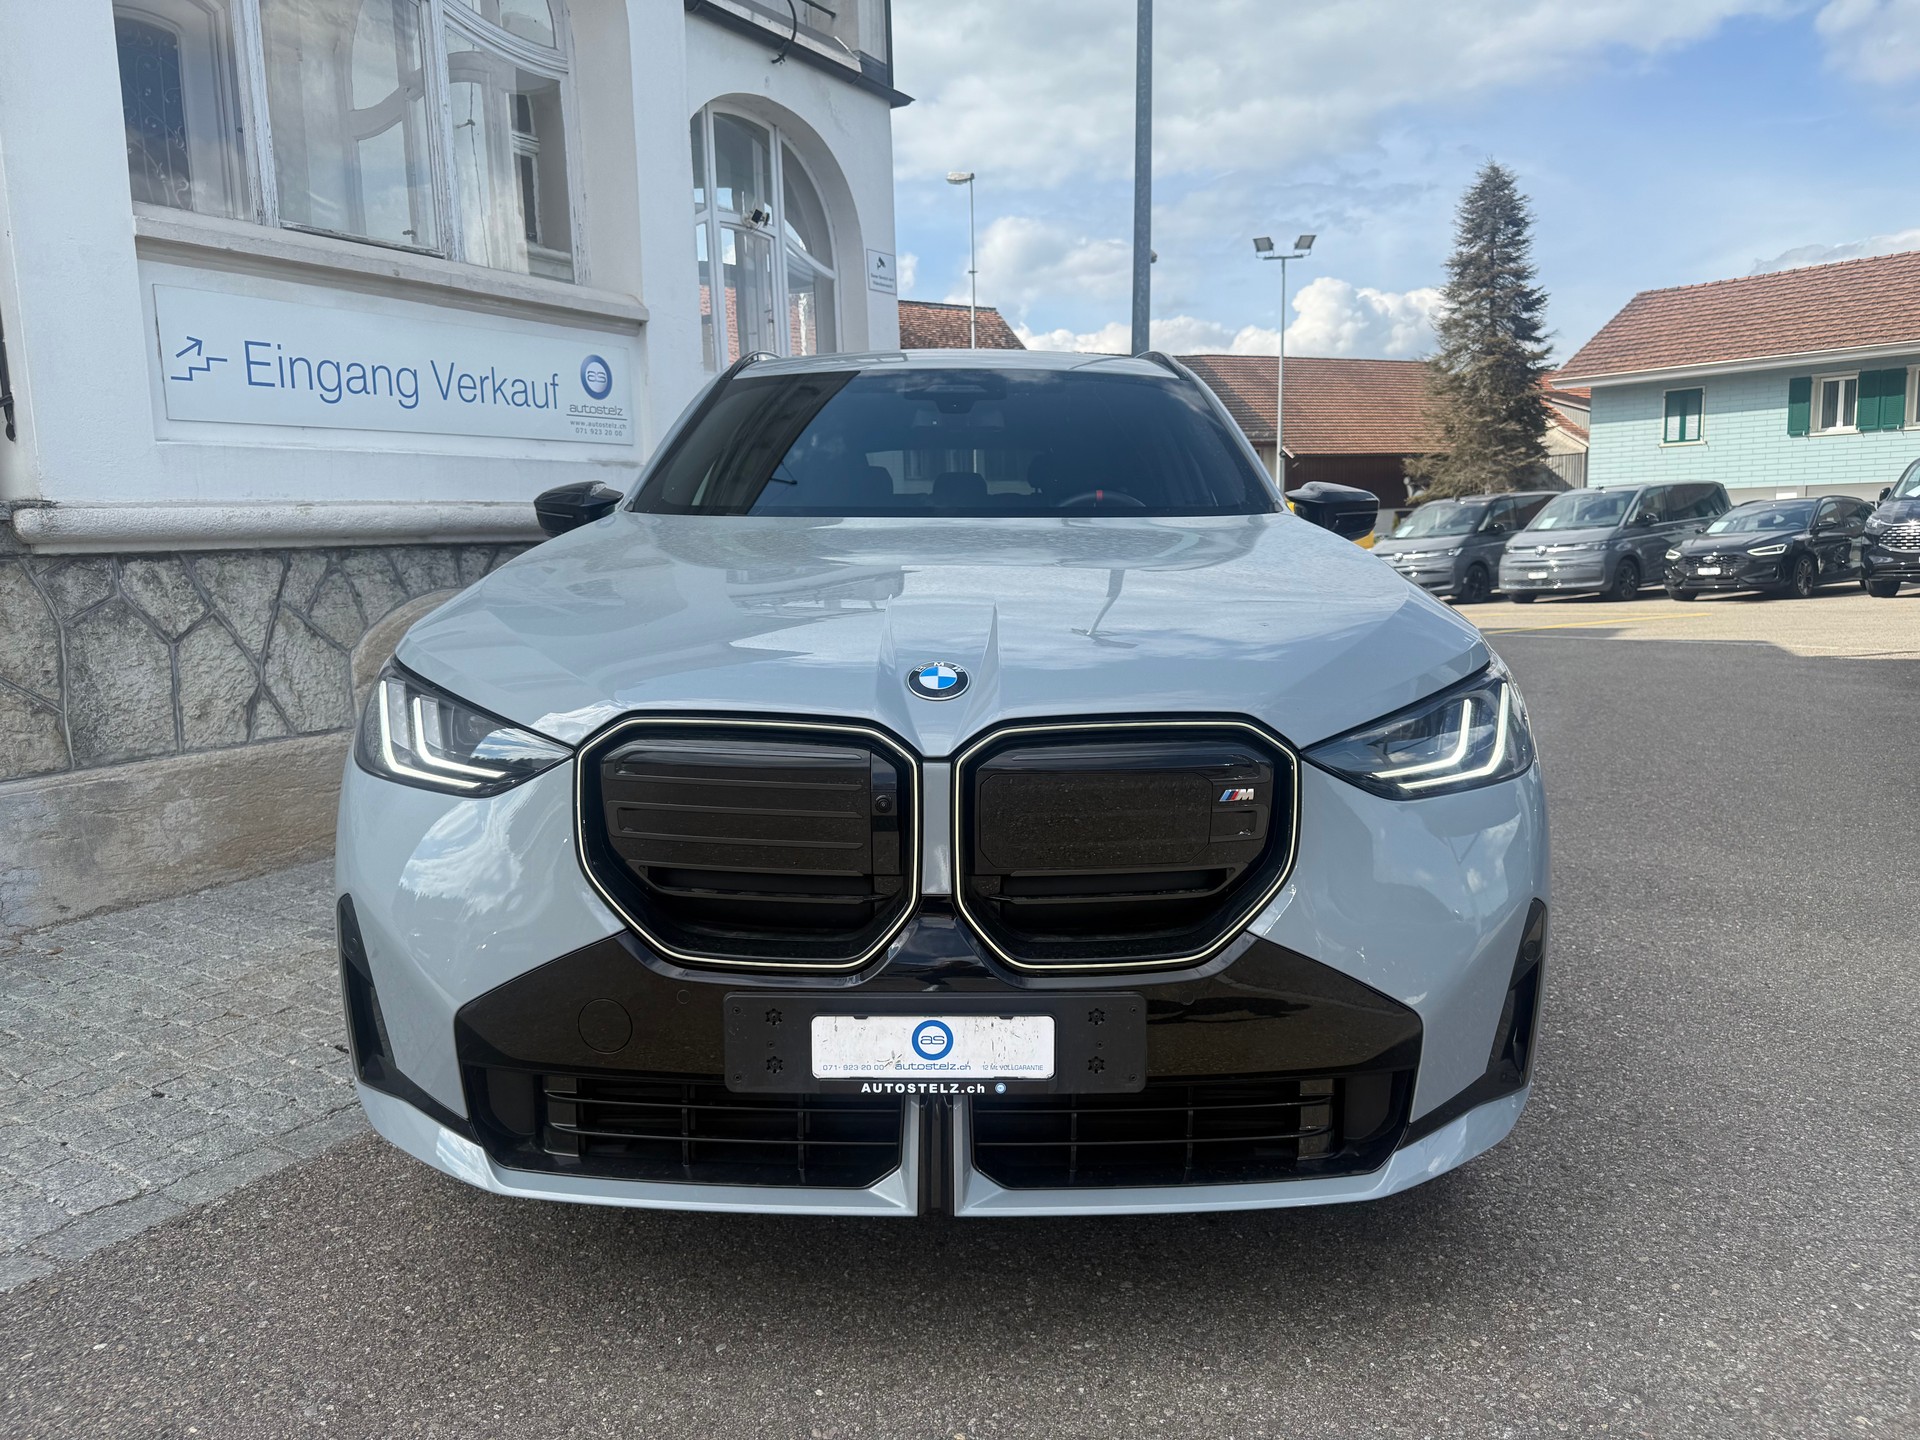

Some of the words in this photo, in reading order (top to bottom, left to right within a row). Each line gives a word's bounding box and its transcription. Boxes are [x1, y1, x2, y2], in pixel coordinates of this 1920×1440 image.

[244, 339, 419, 409] Eingang
[430, 359, 559, 410] Verkauf
[569, 404, 623, 416] autostelz
[570, 420, 627, 430] www.autostelz.ch
[575, 427, 587, 435] 071
[590, 428, 603, 436] 923
[614, 429, 623, 437] 00
[920, 1034, 946, 1046] as
[894, 1062, 971, 1071] autostelz.ch
[861, 1083, 985, 1094] AUTOSTELZ.ch
